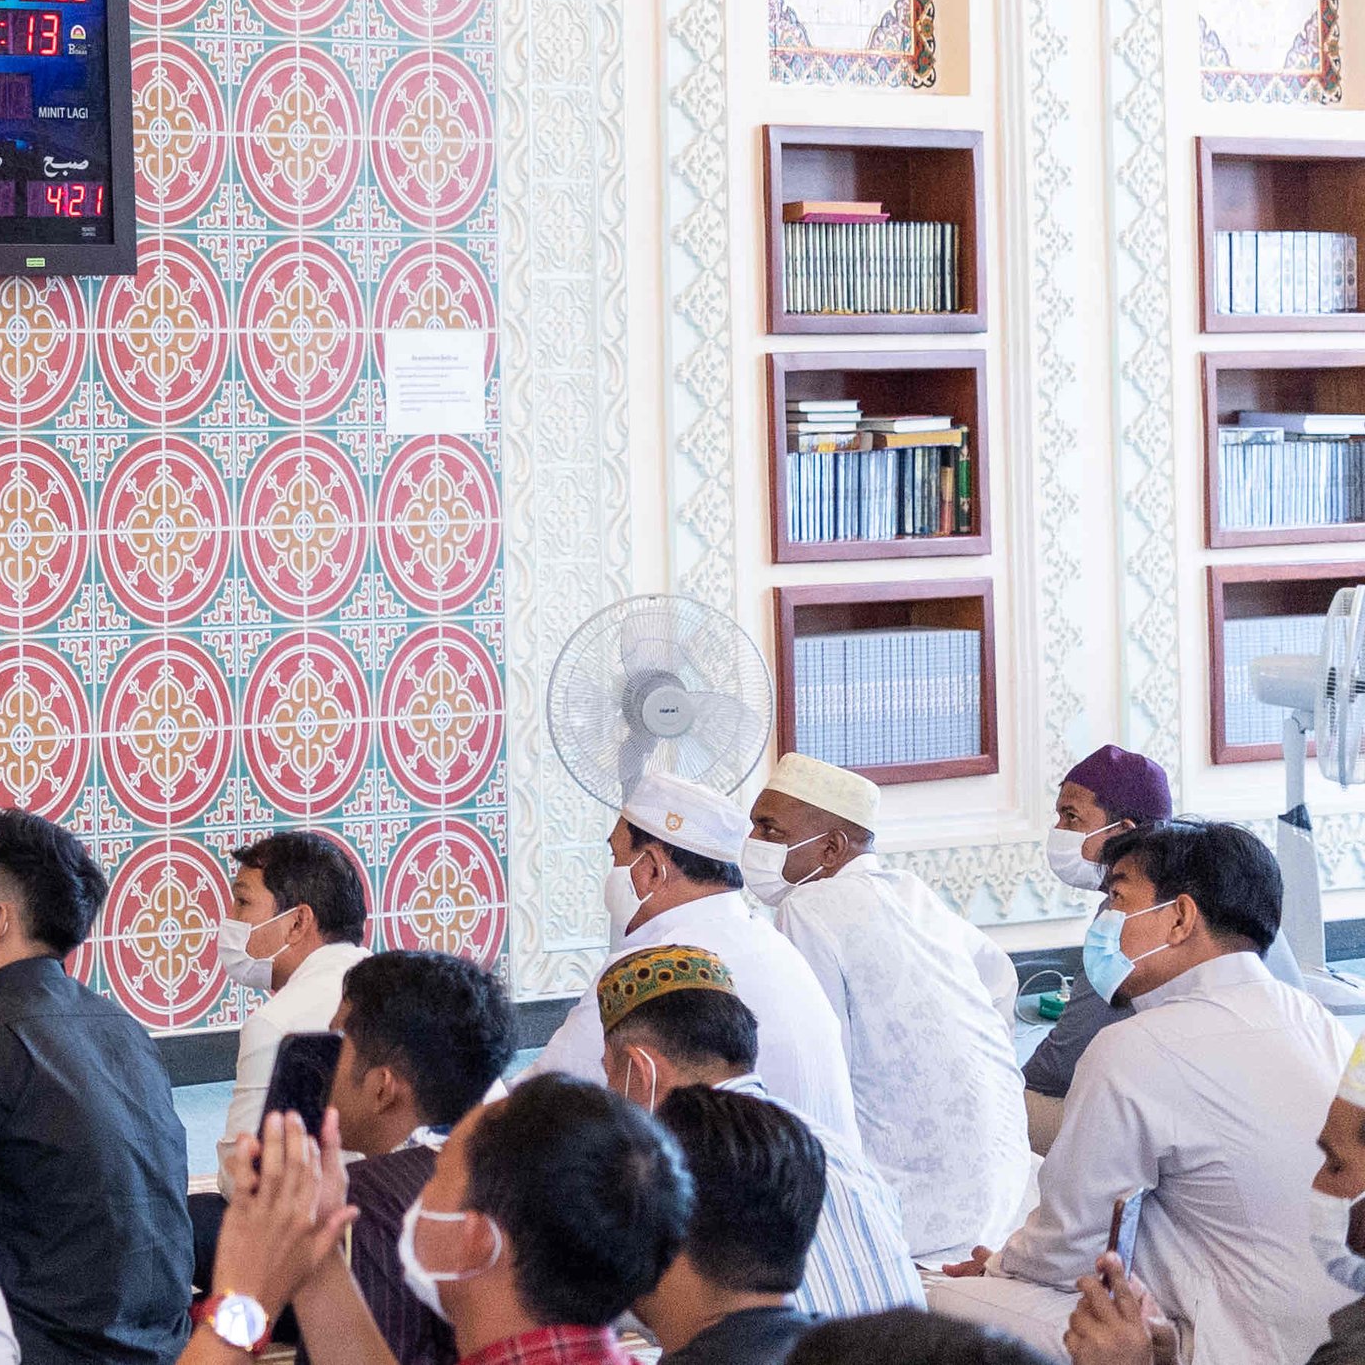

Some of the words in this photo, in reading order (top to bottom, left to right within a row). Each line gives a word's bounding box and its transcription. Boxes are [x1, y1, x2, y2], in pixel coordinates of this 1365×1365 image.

[38, 106, 66, 119] MINIT
[66, 106, 89, 120] LAGI
[42, 154, 90, 178] صبح
[45, 184, 105, 218] 4:21
